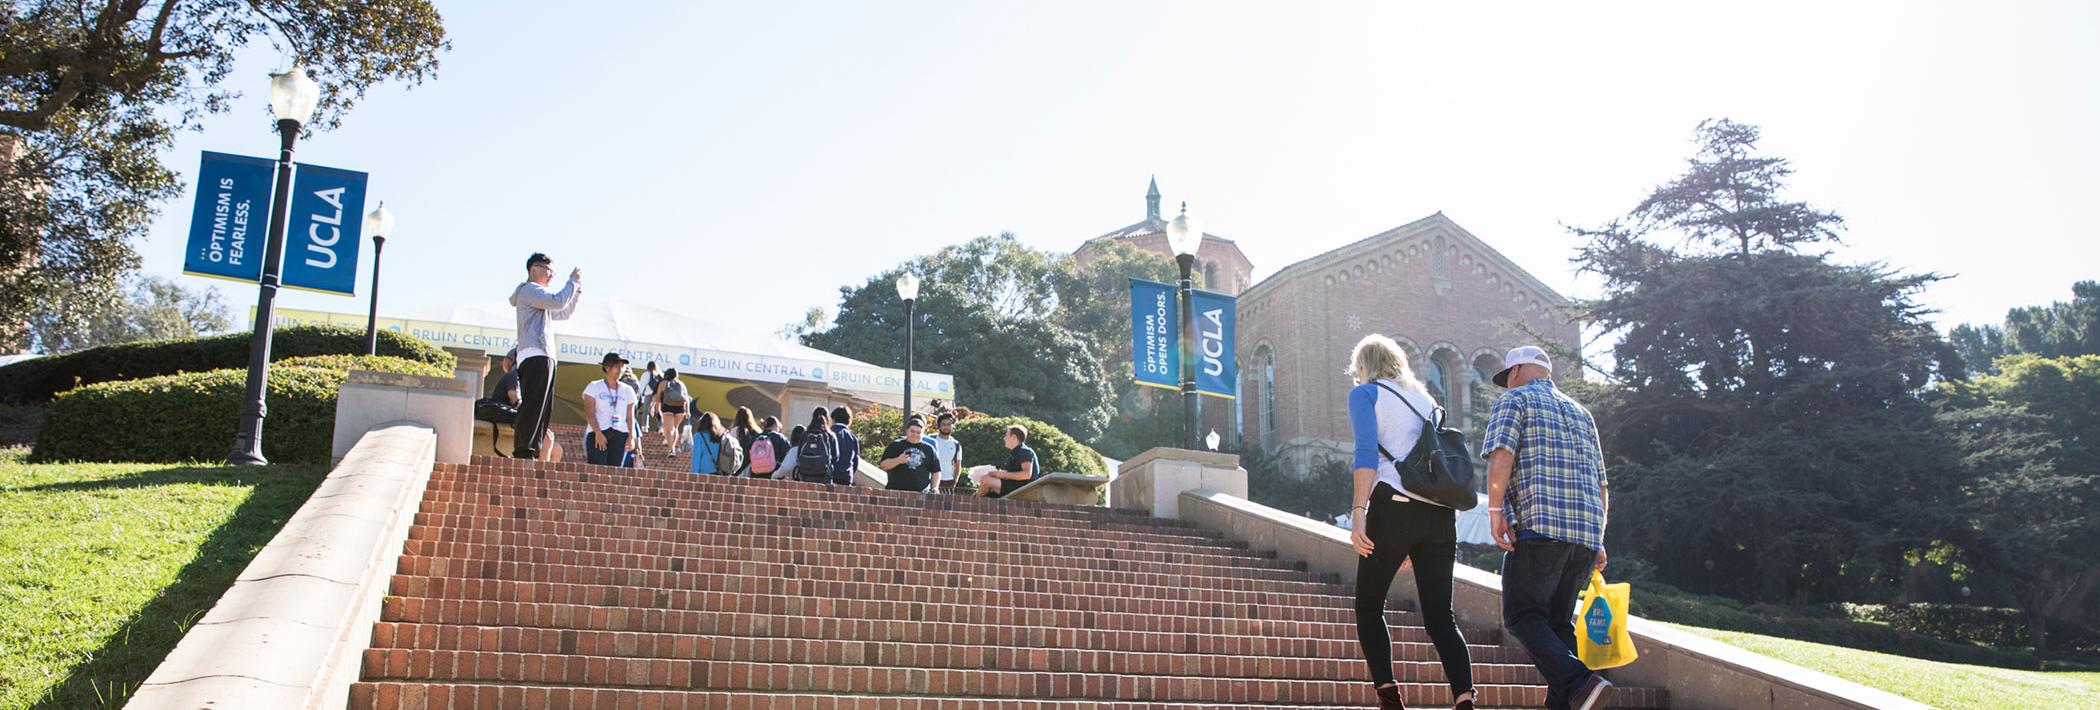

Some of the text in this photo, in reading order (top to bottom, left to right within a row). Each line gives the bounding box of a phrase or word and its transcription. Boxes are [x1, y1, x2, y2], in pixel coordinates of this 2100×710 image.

[209, 178, 234, 262] OPTIMISM IS
[229, 199, 250, 265] FEARLESS.
[305, 187, 345, 268] UCLA
[412, 328, 518, 348] BRUIN CENTRA
[560, 343, 602, 357] BRUIN
[1146, 315, 1156, 373] OPTIMISM
[1157, 291, 1168, 375] OPENS DOORS.
[1203, 309, 1222, 376] UCLA
[700, 357, 805, 377] BRUIN CENTRAL
[833, 370, 932, 390] BRUIN CENRAL
